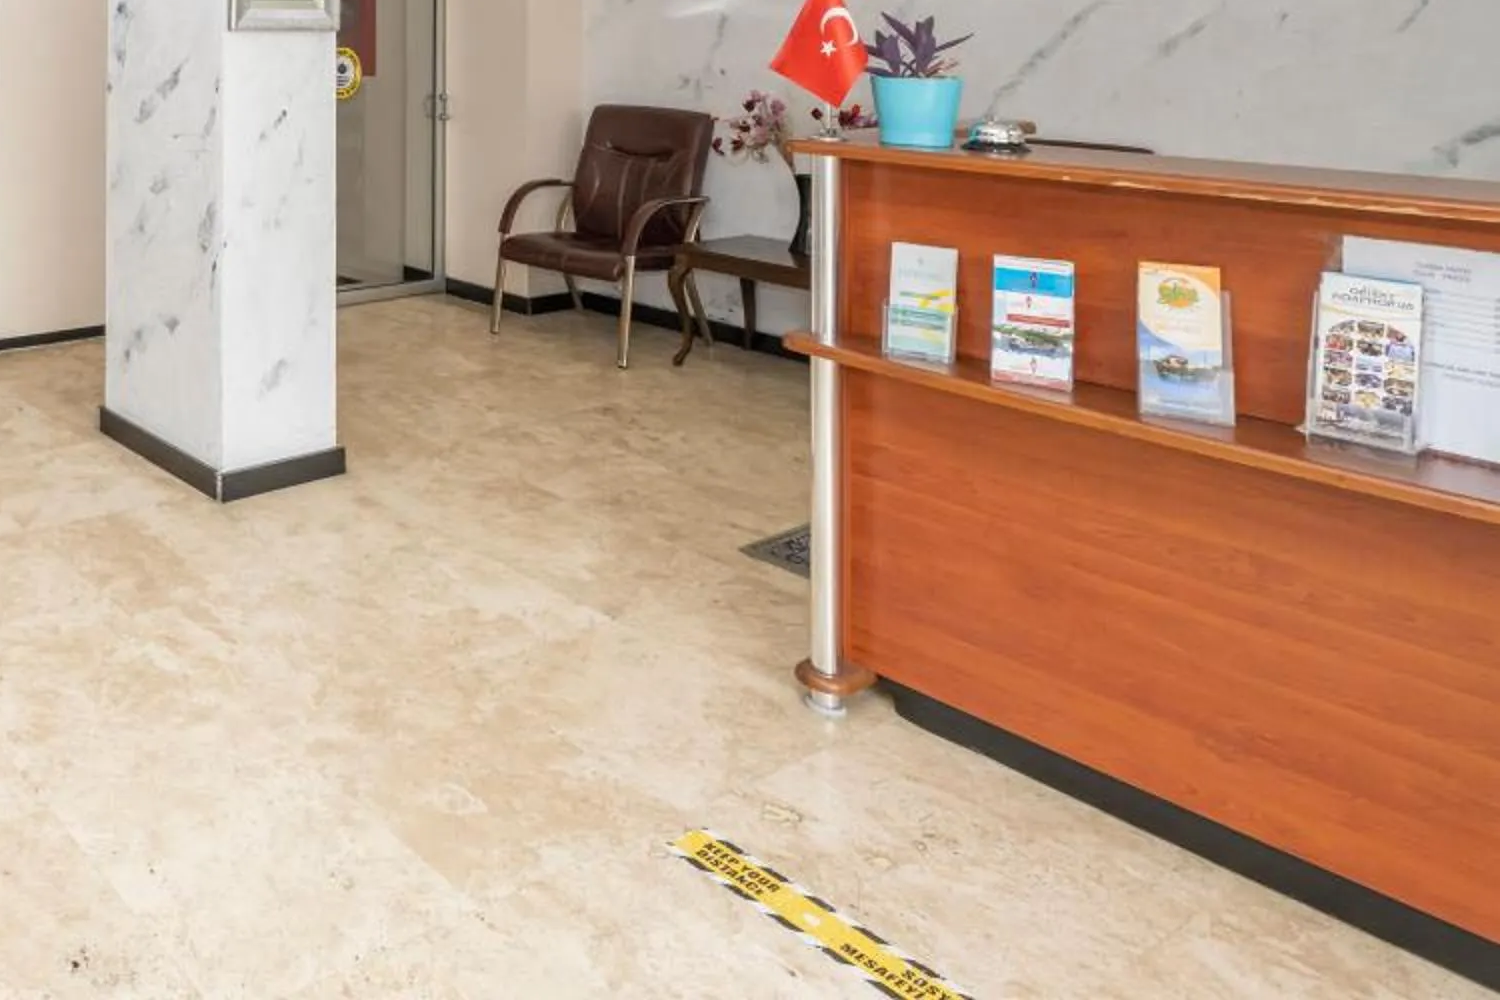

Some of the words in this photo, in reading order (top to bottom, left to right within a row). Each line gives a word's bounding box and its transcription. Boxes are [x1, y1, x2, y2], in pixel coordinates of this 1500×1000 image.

[696, 849, 764, 895] DISTANCE
[703, 842, 740, 864] KEEP
[741, 865, 780, 892] YOUR
